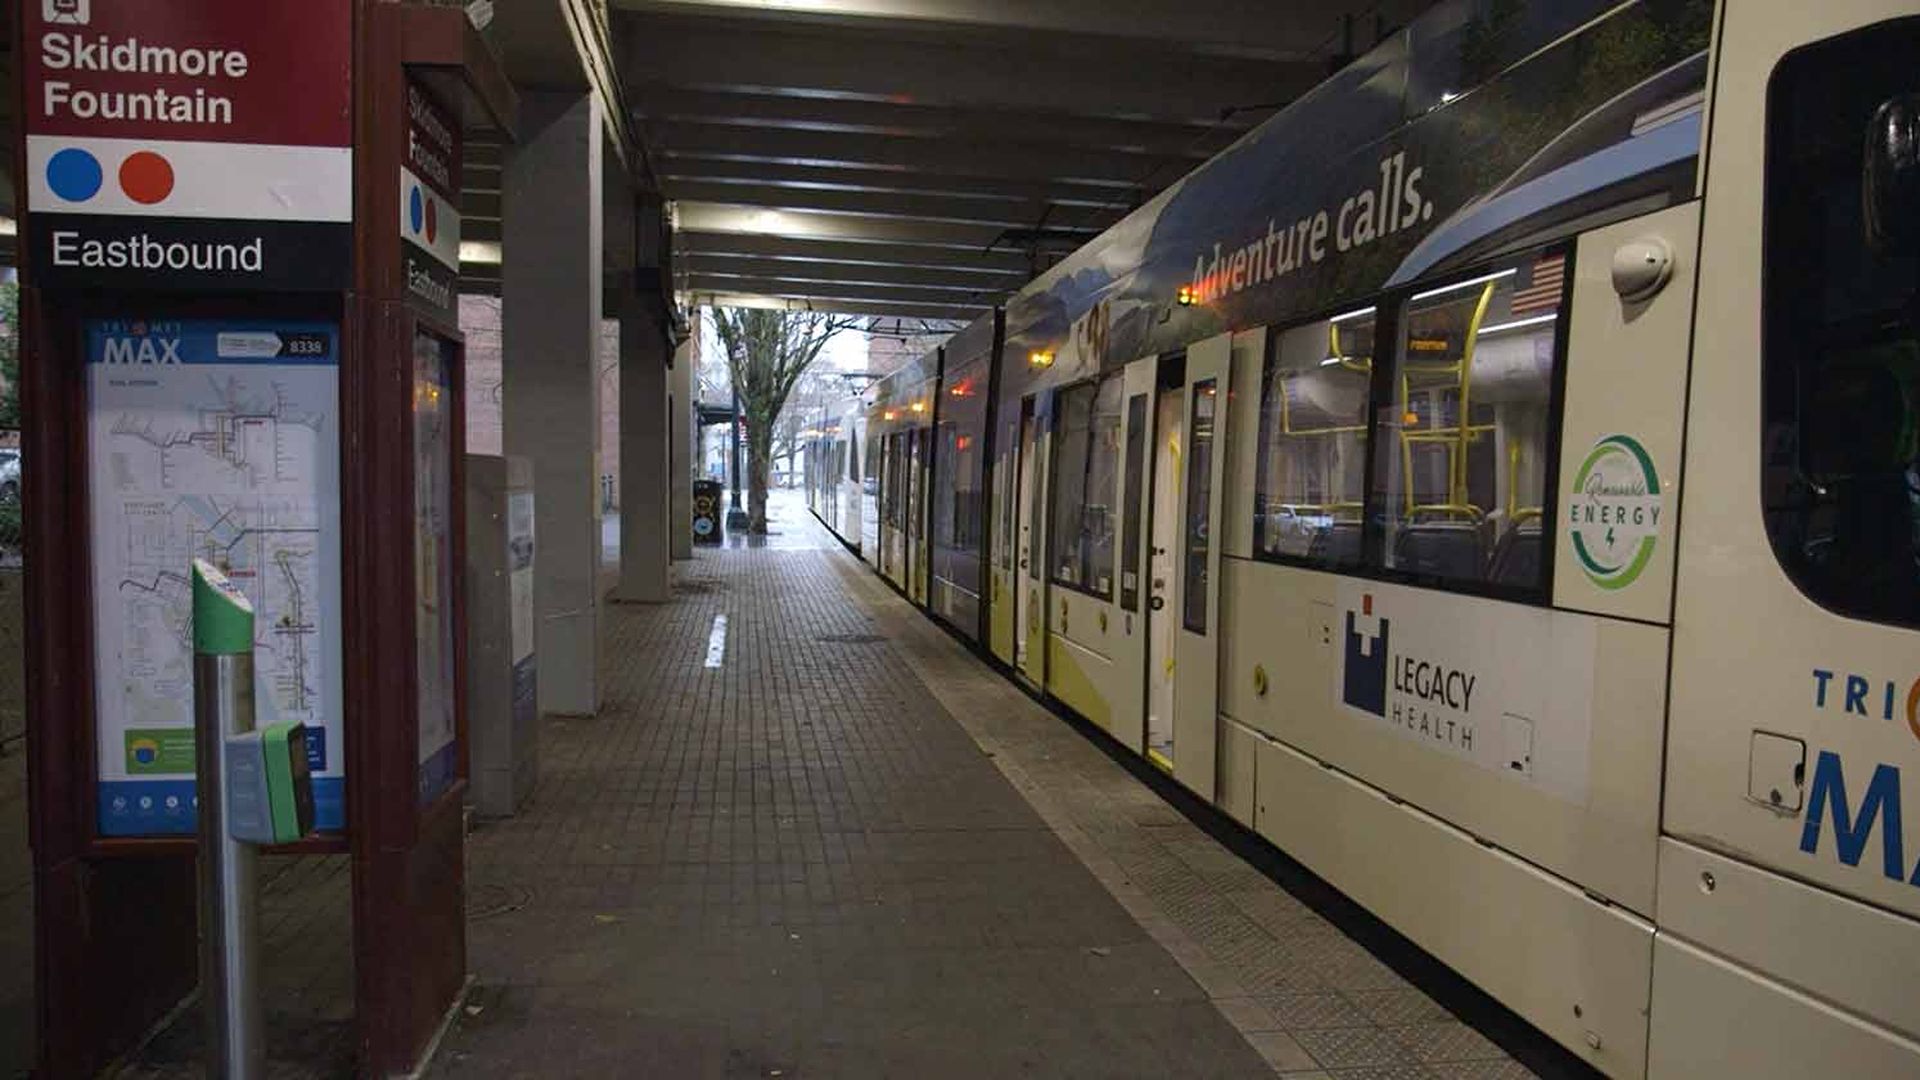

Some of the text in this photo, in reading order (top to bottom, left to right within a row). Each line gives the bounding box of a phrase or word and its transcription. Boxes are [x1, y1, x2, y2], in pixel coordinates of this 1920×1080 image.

[42, 32, 249, 77] Skidmore
[43, 81, 233, 124] Fountain
[1192, 151, 1434, 303] Adventure calls.
[52, 231, 263, 272] Eastbound
[104, 338, 182, 366] MAX
[1570, 505, 1660, 525] ENERGY
[1394, 654, 1476, 712] LEGACY
[1392, 702, 1473, 751] HEALTH
[1799, 750, 1920, 887] M
